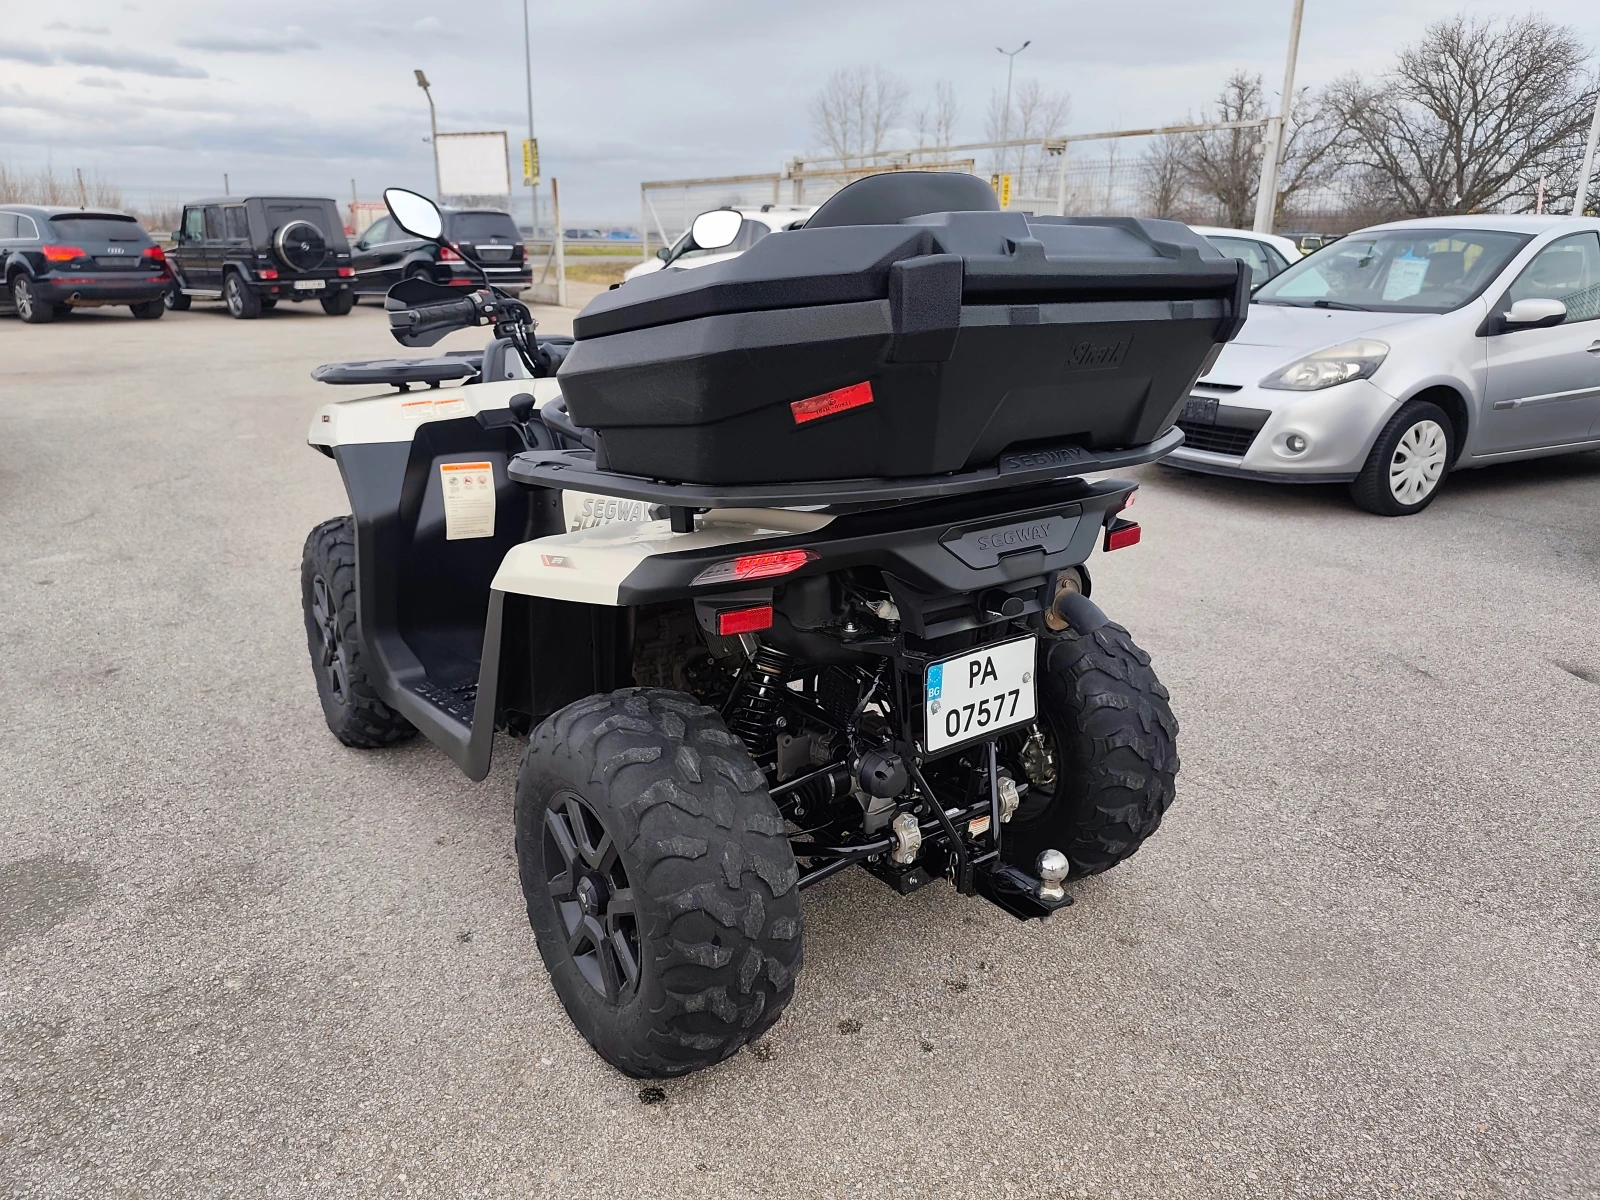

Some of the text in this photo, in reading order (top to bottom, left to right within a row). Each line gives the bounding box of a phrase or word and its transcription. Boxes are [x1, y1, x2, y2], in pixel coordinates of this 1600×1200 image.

[1005, 447, 1082, 469] SEGWAY
[977, 523, 1051, 551] SEGWAY
[968, 655, 998, 689] PA
[928, 686, 940, 698] BG
[945, 688, 1020, 738] 07577
